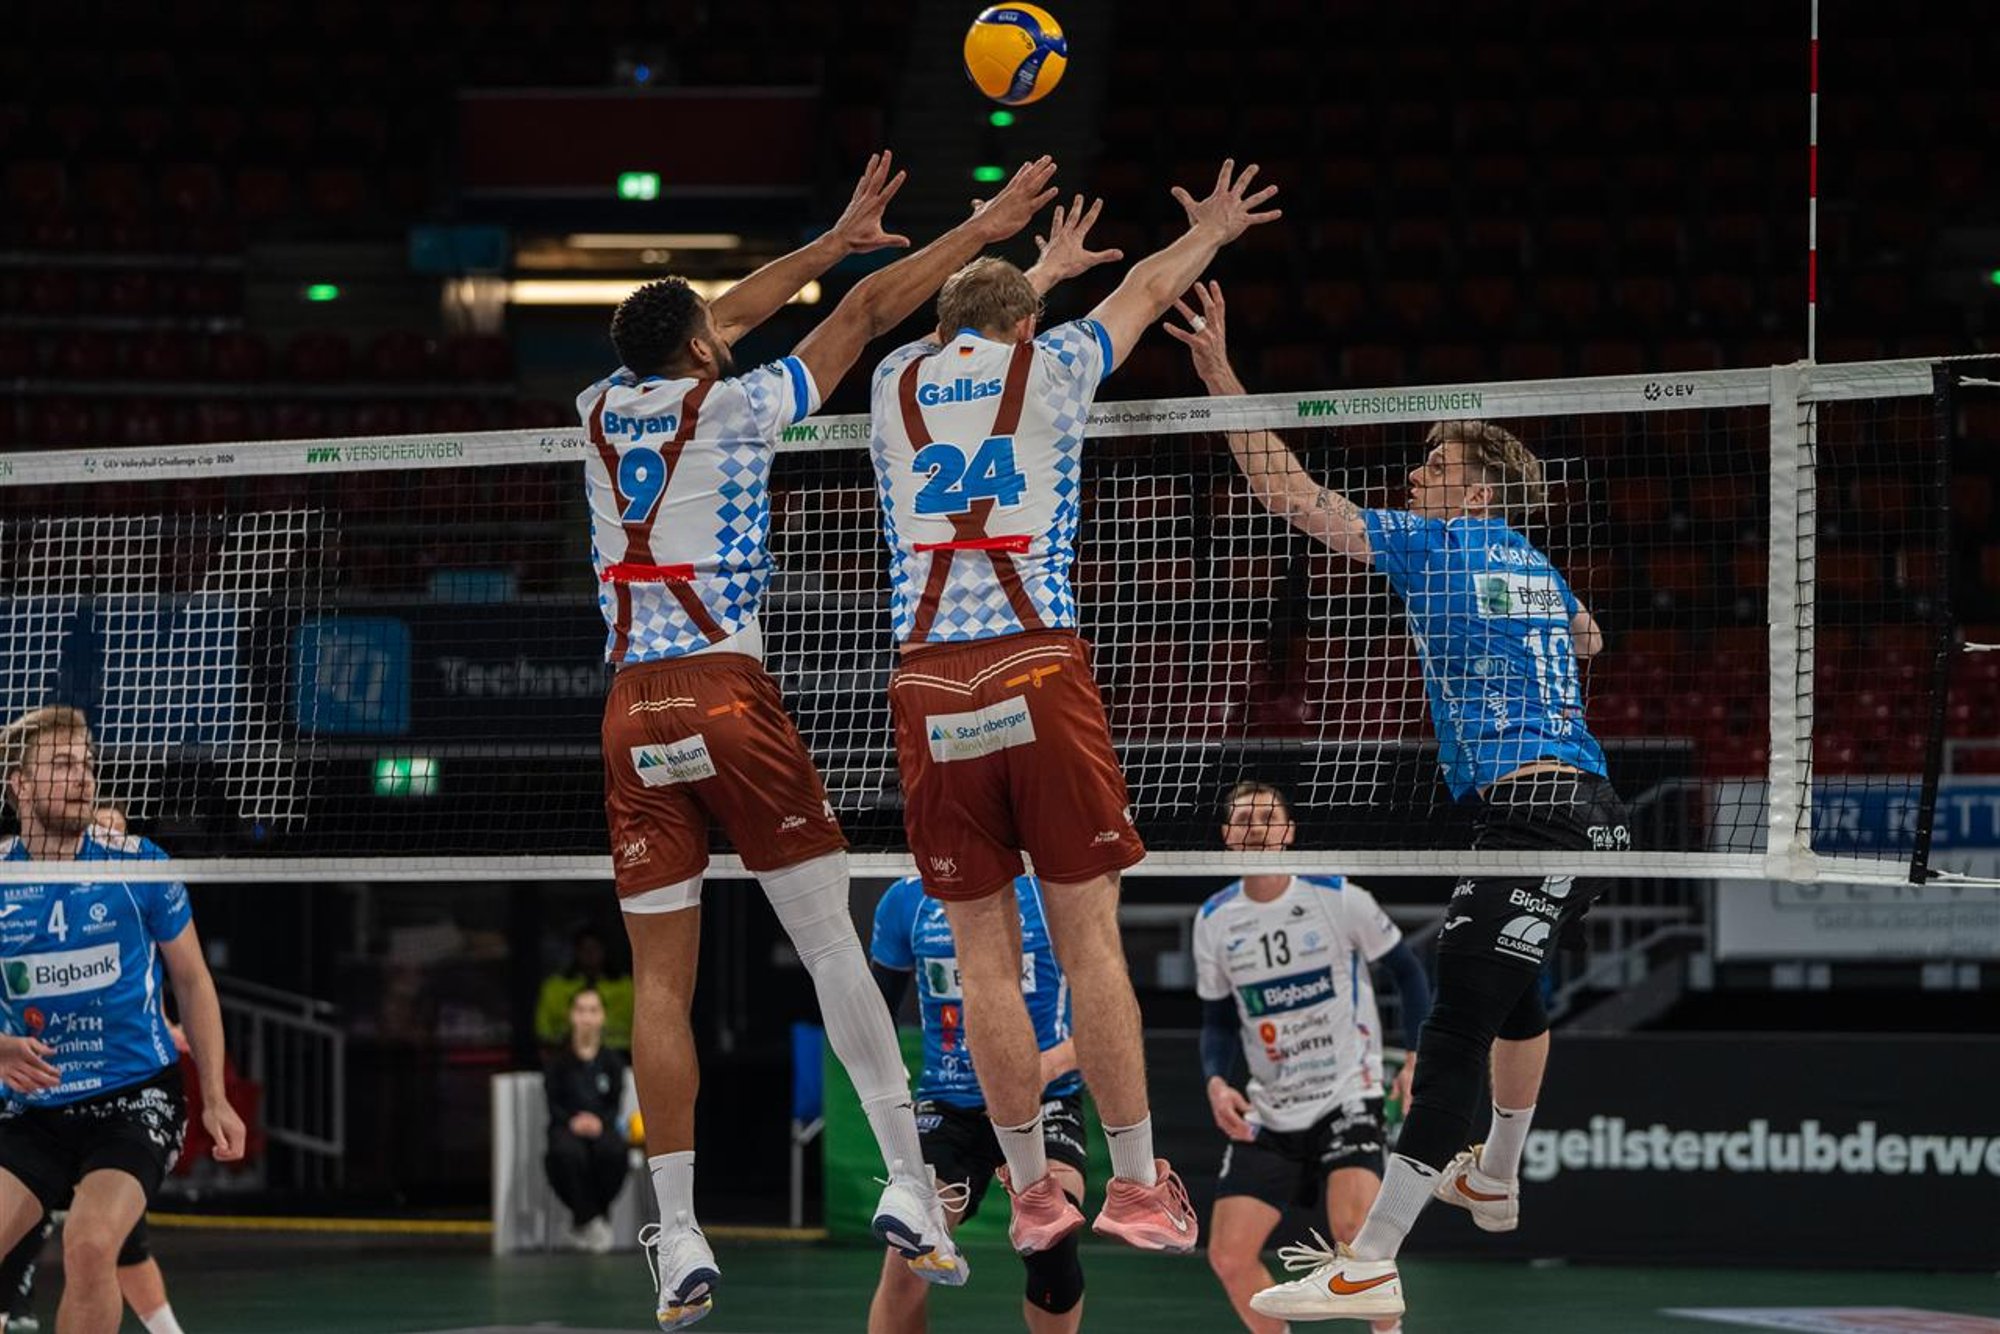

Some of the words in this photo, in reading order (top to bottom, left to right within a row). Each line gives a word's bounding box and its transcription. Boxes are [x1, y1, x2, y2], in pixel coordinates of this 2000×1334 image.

[917, 378, 1002, 406] Gallas
[1297, 400, 1338, 417] WWK
[1341, 393, 1482, 414] VERSICHERUNGEN
[1664, 384, 1695, 397] CEV
[603, 410, 678, 442] Bryan
[1121, 412, 1167, 423] Challenge
[1168, 411, 1188, 421] Cup
[1189, 409, 1211, 419] 2026
[781, 424, 819, 441] WWK
[822, 423, 872, 440] VERSIC
[307, 447, 341, 463] WWK
[345, 442, 464, 461] VERSICHERUNGEN
[617, 447, 667, 523] 9
[911, 436, 1028, 515] 24
[956, 711, 1027, 740] Starnberger
[47, 899, 69, 942] 4
[1259, 929, 1291, 969] 13
[36, 956, 116, 988] Bigbank
[1263, 976, 1331, 1007] Bigbank
